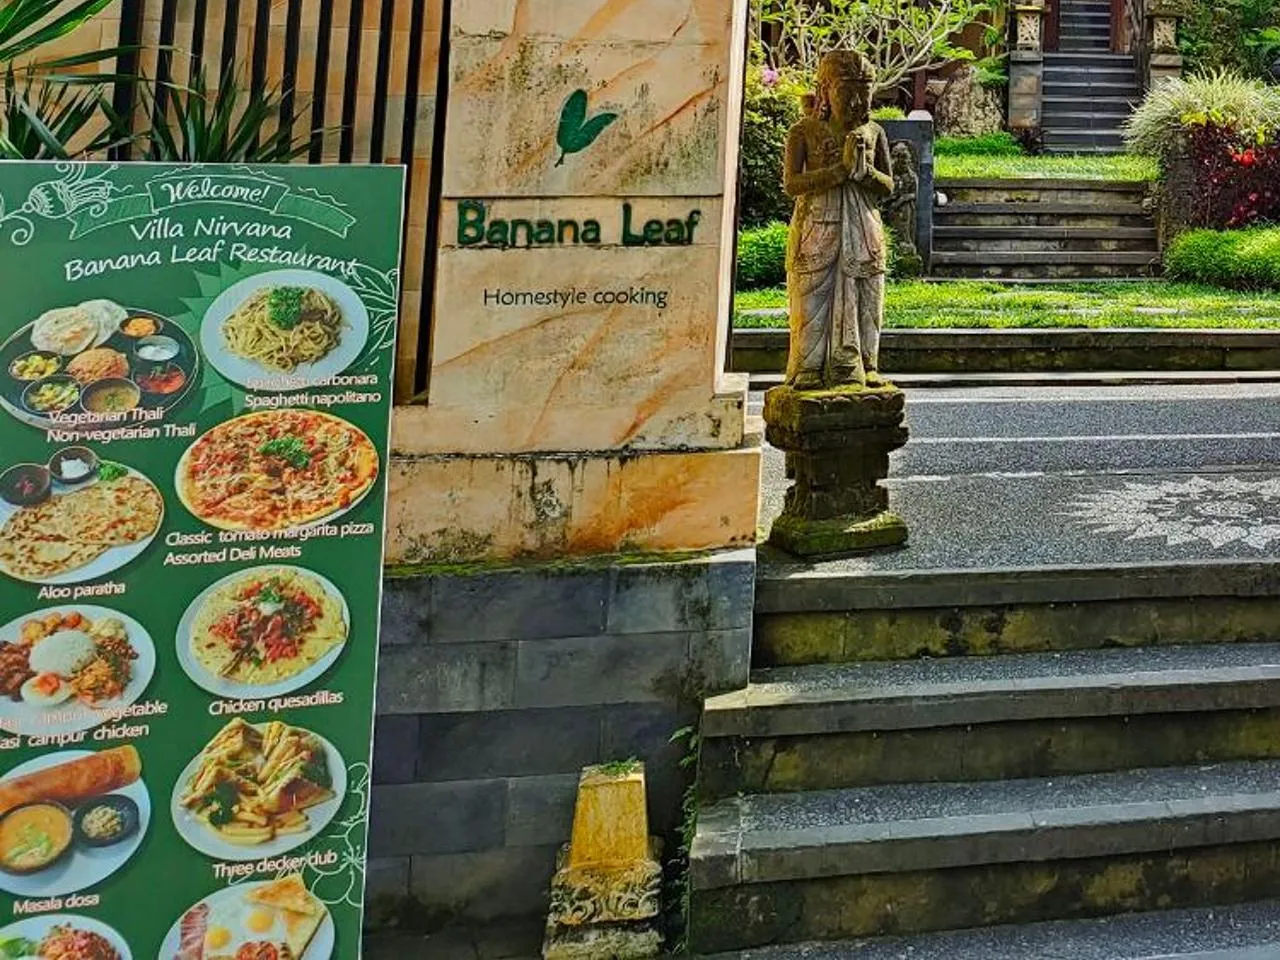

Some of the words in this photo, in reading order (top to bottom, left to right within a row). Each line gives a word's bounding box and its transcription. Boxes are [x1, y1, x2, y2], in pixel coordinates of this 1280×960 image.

[160, 178, 271, 204] Welcome!
[130, 217, 184, 240] Villa
[194, 216, 292, 239] Nirvana
[457, 200, 601, 246] Banana
[622, 202, 702, 246] Leaf
[64, 250, 161, 281] Banana
[171, 240, 225, 263] Leaf
[230, 243, 358, 276] Restaurant
[484, 287, 587, 309] Homestyle
[593, 287, 669, 309] cooking
[313, 374, 378, 386] carbonara
[245, 392, 309, 409] Spaghetti
[311, 390, 382, 408] napolitano
[49, 411, 127, 426] Vegetarian
[46, 426, 160, 444] Non-vegetarian
[163, 423, 197, 437] Thali
[165, 531, 212, 546] Classic
[219, 528, 270, 543] tomato
[340, 521, 374, 538] pizza
[163, 548, 226, 566] Assorted
[229, 546, 257, 561] Deli
[259, 544, 301, 559] Meats
[37, 585, 71, 600] Aloo
[73, 580, 126, 600] paratha
[208, 699, 265, 715] Chicken
[267, 690, 344, 712] quesadillas
[0, 733, 20, 749] asi
[28, 731, 87, 748] campur
[93, 723, 149, 741] chicken
[212, 862, 254, 878] Three
[256, 854, 306, 872] decker
[13, 896, 62, 914] Masala
[65, 893, 100, 908] dosa
